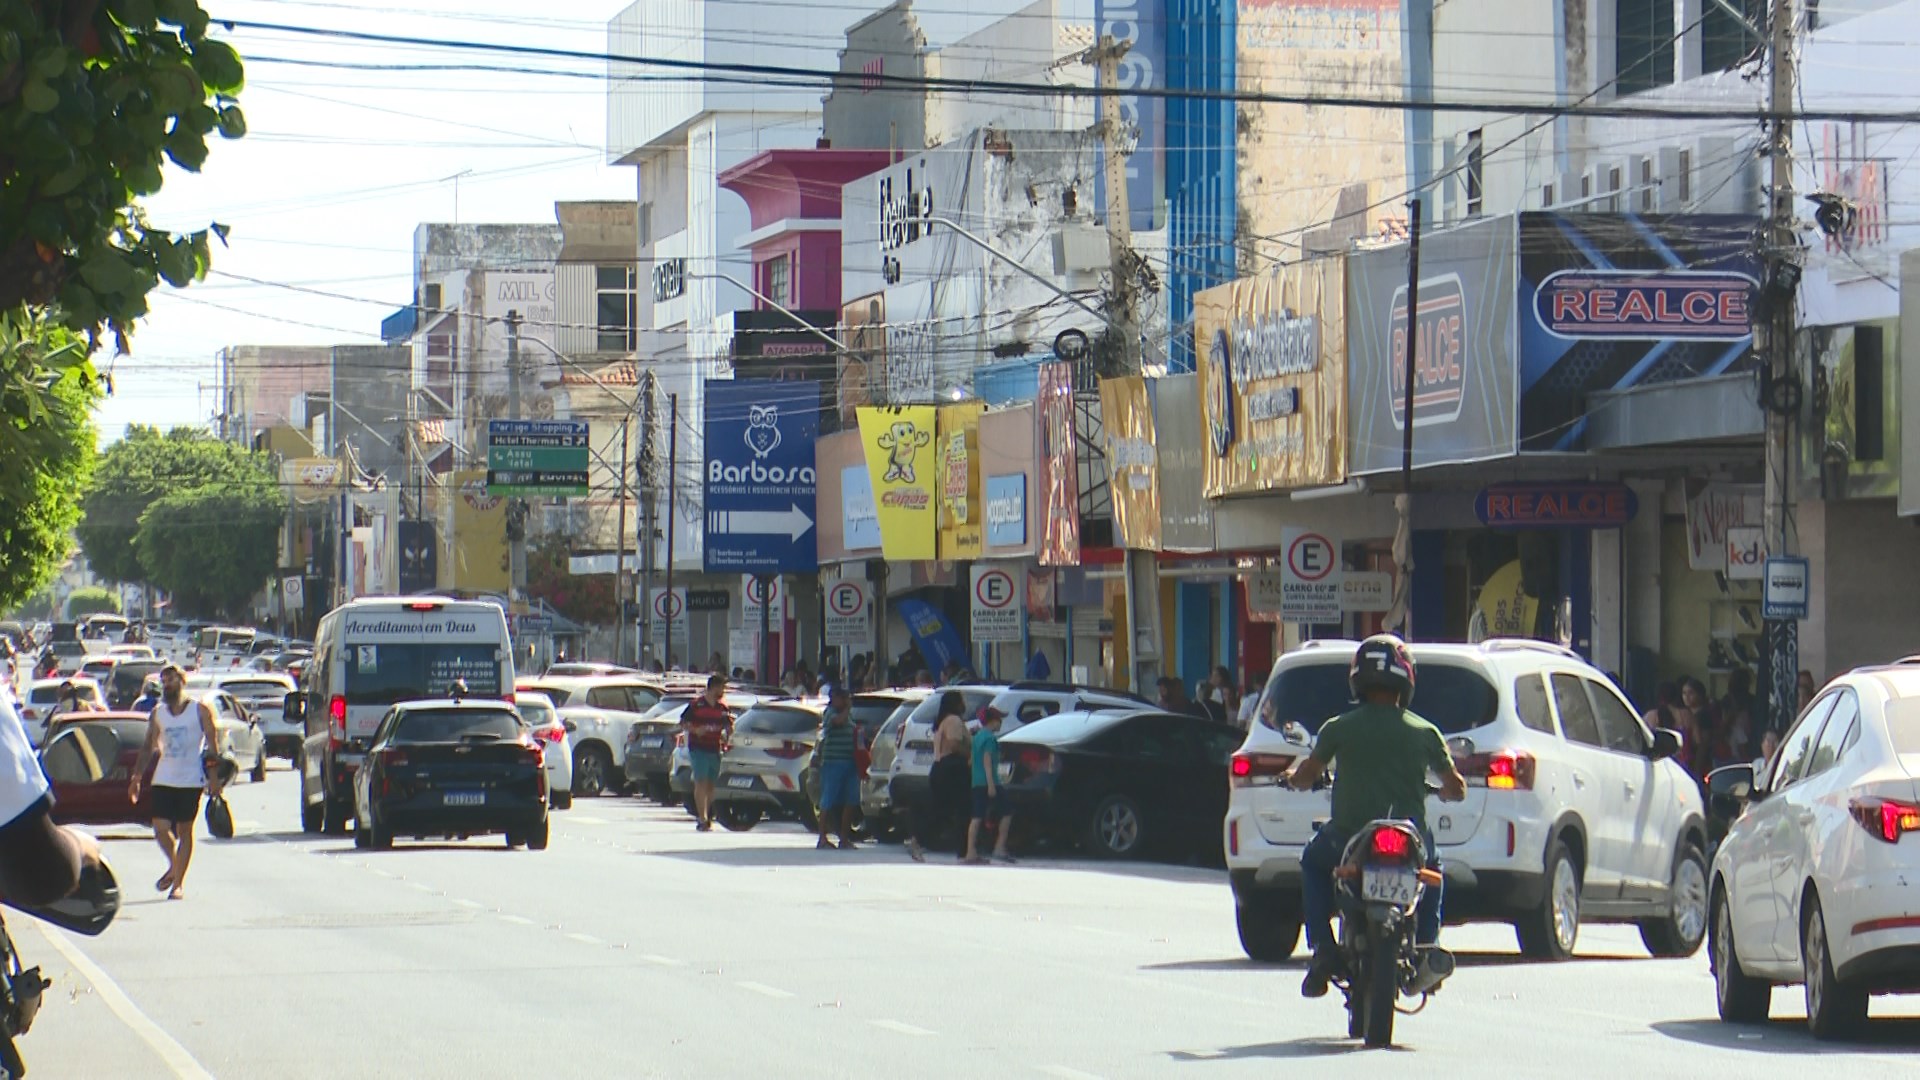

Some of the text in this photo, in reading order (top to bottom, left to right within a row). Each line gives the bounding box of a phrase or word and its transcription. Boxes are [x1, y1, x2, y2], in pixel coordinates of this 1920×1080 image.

[498, 281, 540, 302] MIL
[1553, 289, 1749, 324] REALCE
[1393, 315, 1461, 392] RALCE
[709, 459, 816, 484] Barbosa
[1487, 494, 1625, 519] REALCE
[1303, 543, 1320, 571] E
[988, 578, 1003, 600] E
[1284, 583, 1312, 593] CARRO
[839, 589, 853, 610] E
[827, 616, 848, 624] CARRO
[973, 609, 996, 617] CARRO
[1494, 600, 1508, 631] ojas
[1767, 605, 1805, 616] ÔNIBUS
[347, 621, 477, 635] Acreditamos em Deus
